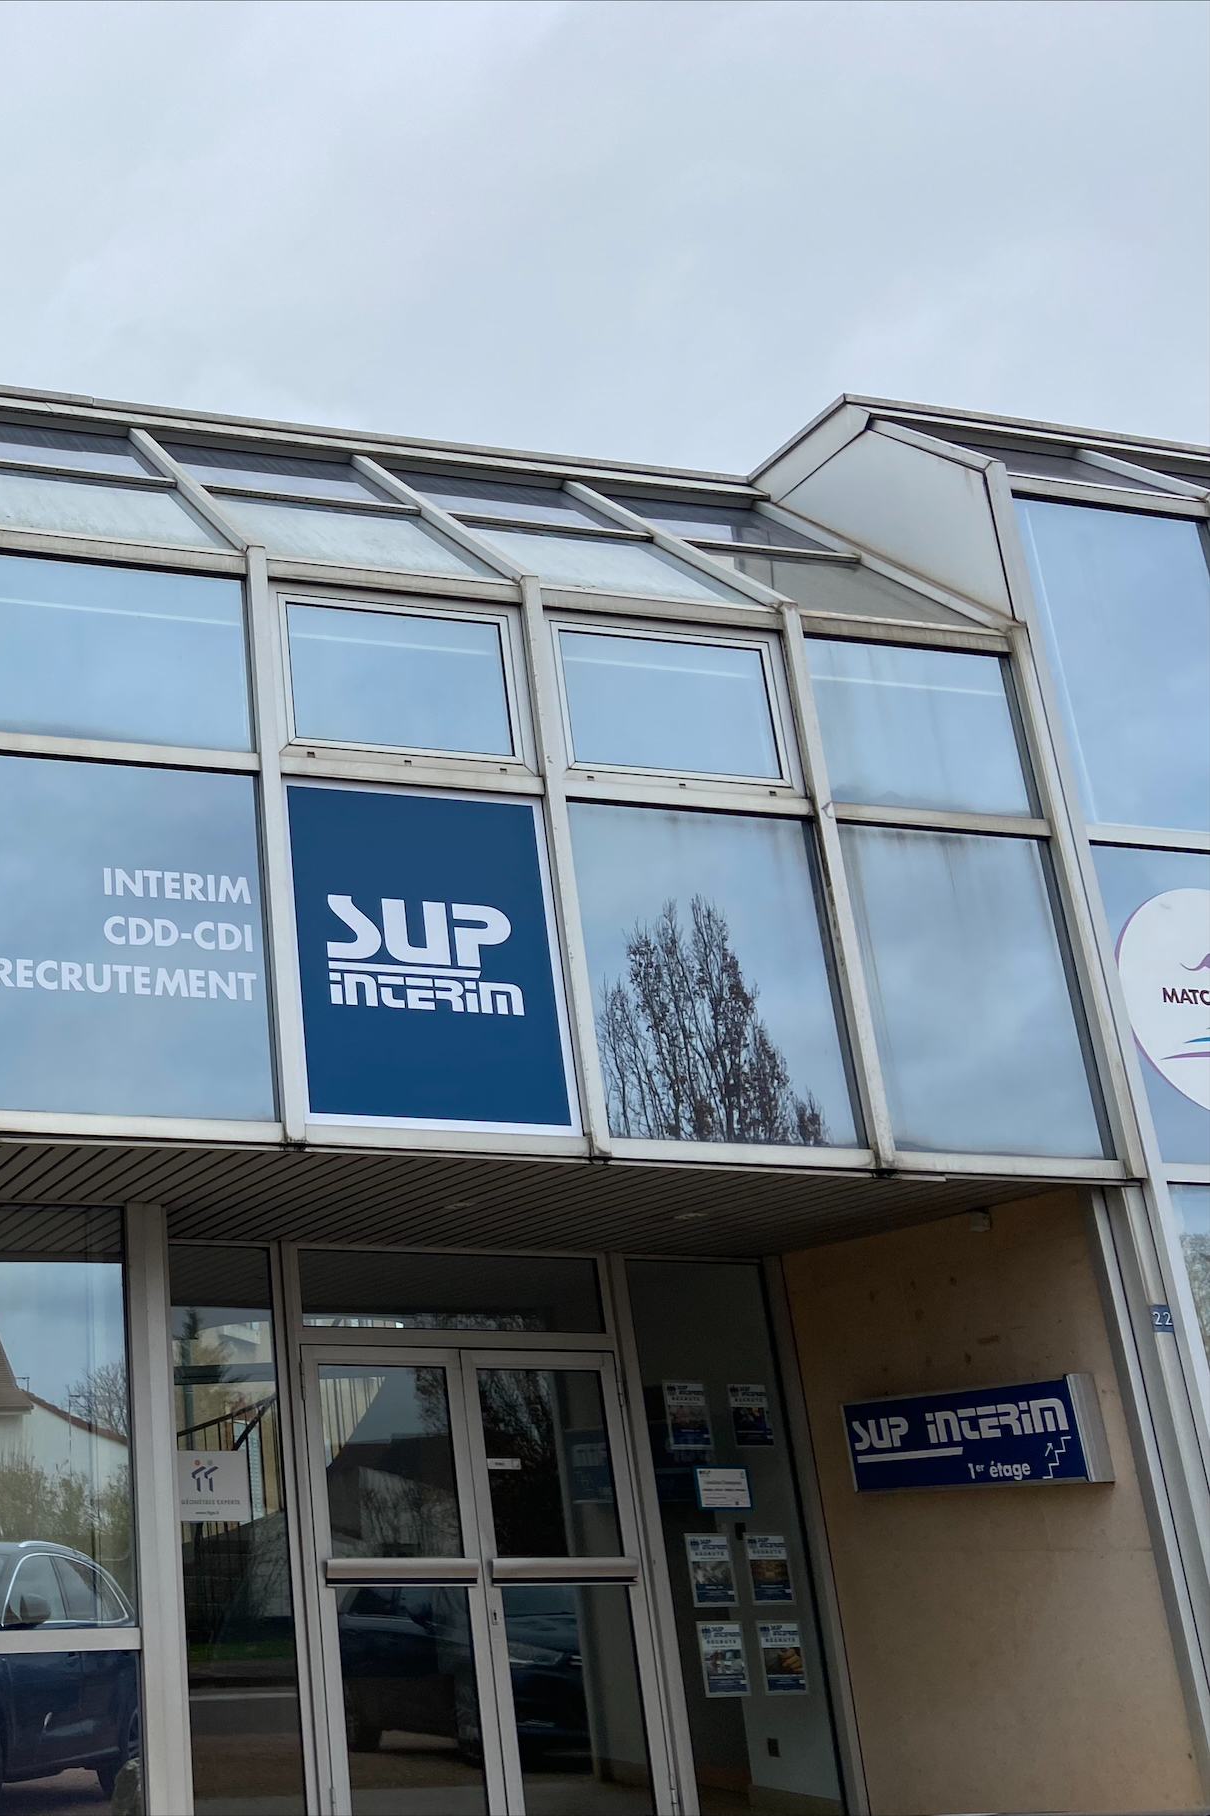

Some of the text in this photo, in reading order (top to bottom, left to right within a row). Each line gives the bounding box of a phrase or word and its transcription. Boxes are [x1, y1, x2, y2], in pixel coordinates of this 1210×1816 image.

[103, 867, 252, 905] INTERIM
[103, 914, 254, 953] CDD-CDI
[326, 894, 512, 968] SUP
[1152, 1311, 1173, 1326] 22
[852, 1416, 908, 1451] SUP
[967, 1460, 1031, 1481] 1er étage
